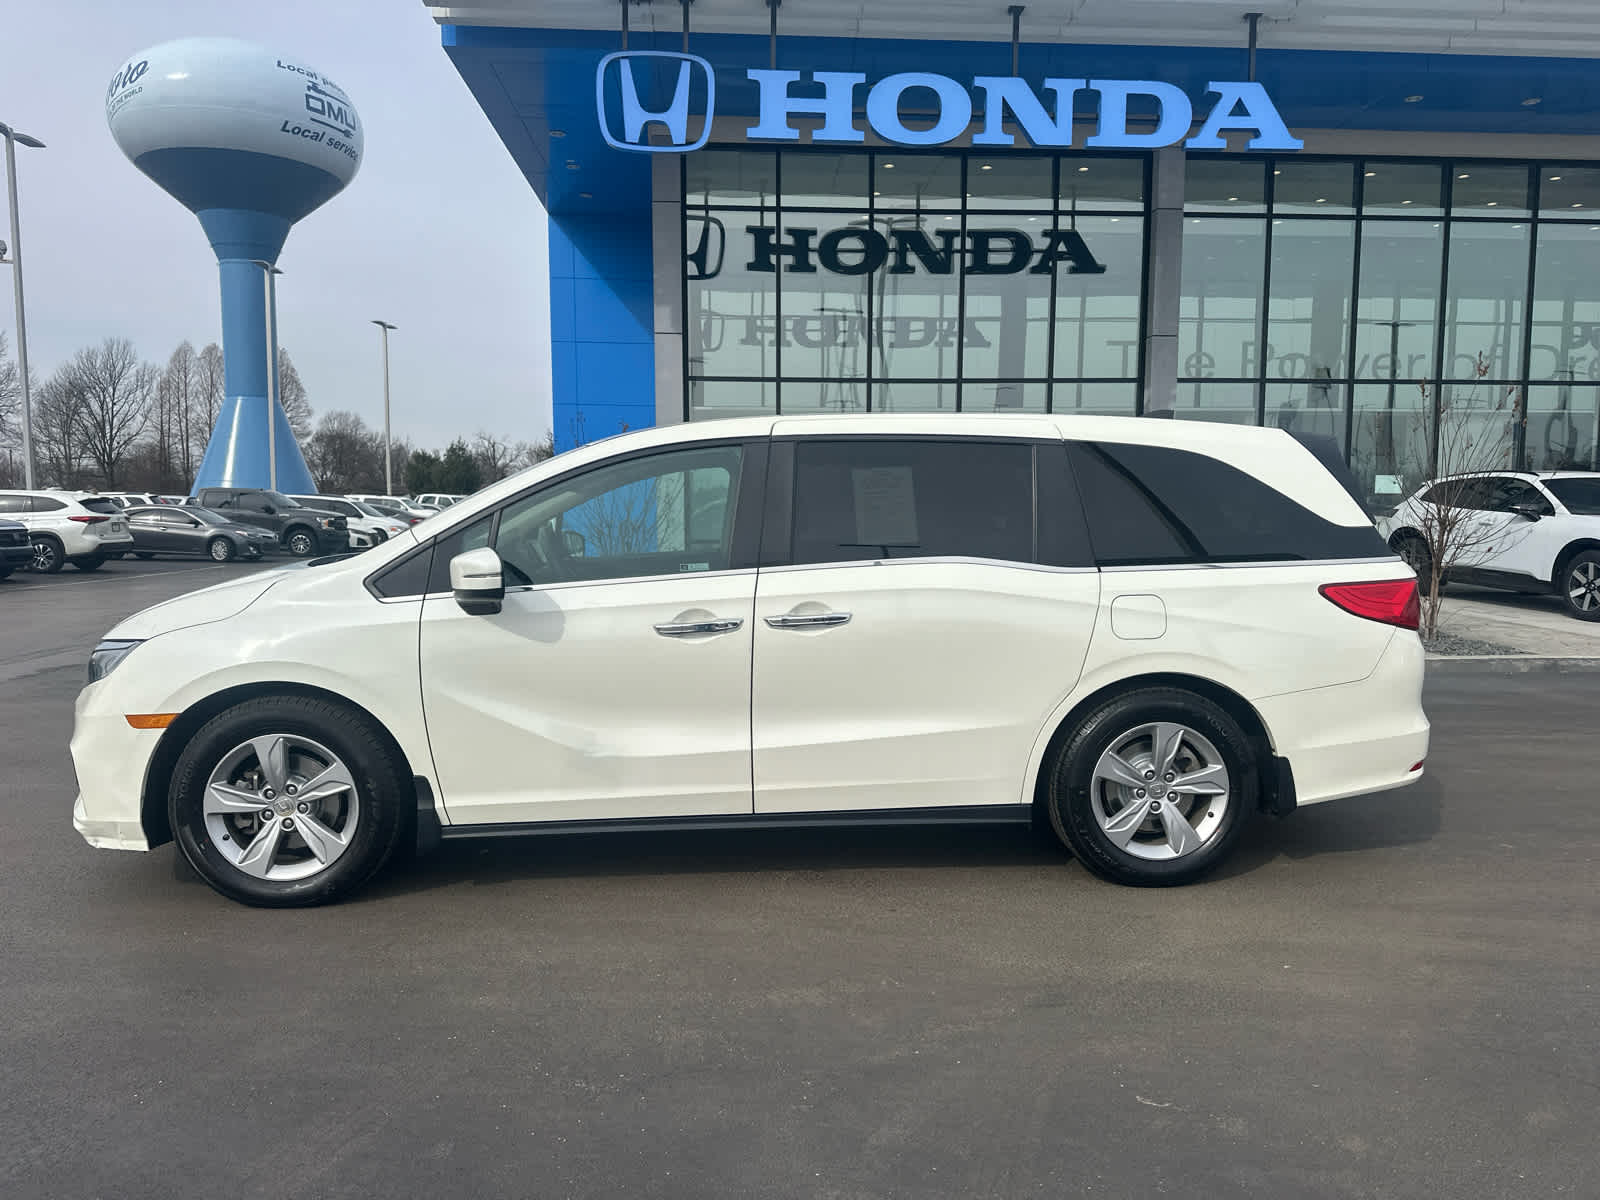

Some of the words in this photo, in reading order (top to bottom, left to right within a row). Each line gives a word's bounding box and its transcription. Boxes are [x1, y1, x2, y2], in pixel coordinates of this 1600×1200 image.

[277, 60, 318, 80] Local
[305, 93, 356, 131] OMU
[746, 69, 1304, 150] HONDA
[280, 120, 326, 142] Local
[746, 226, 1107, 276] HONDA
